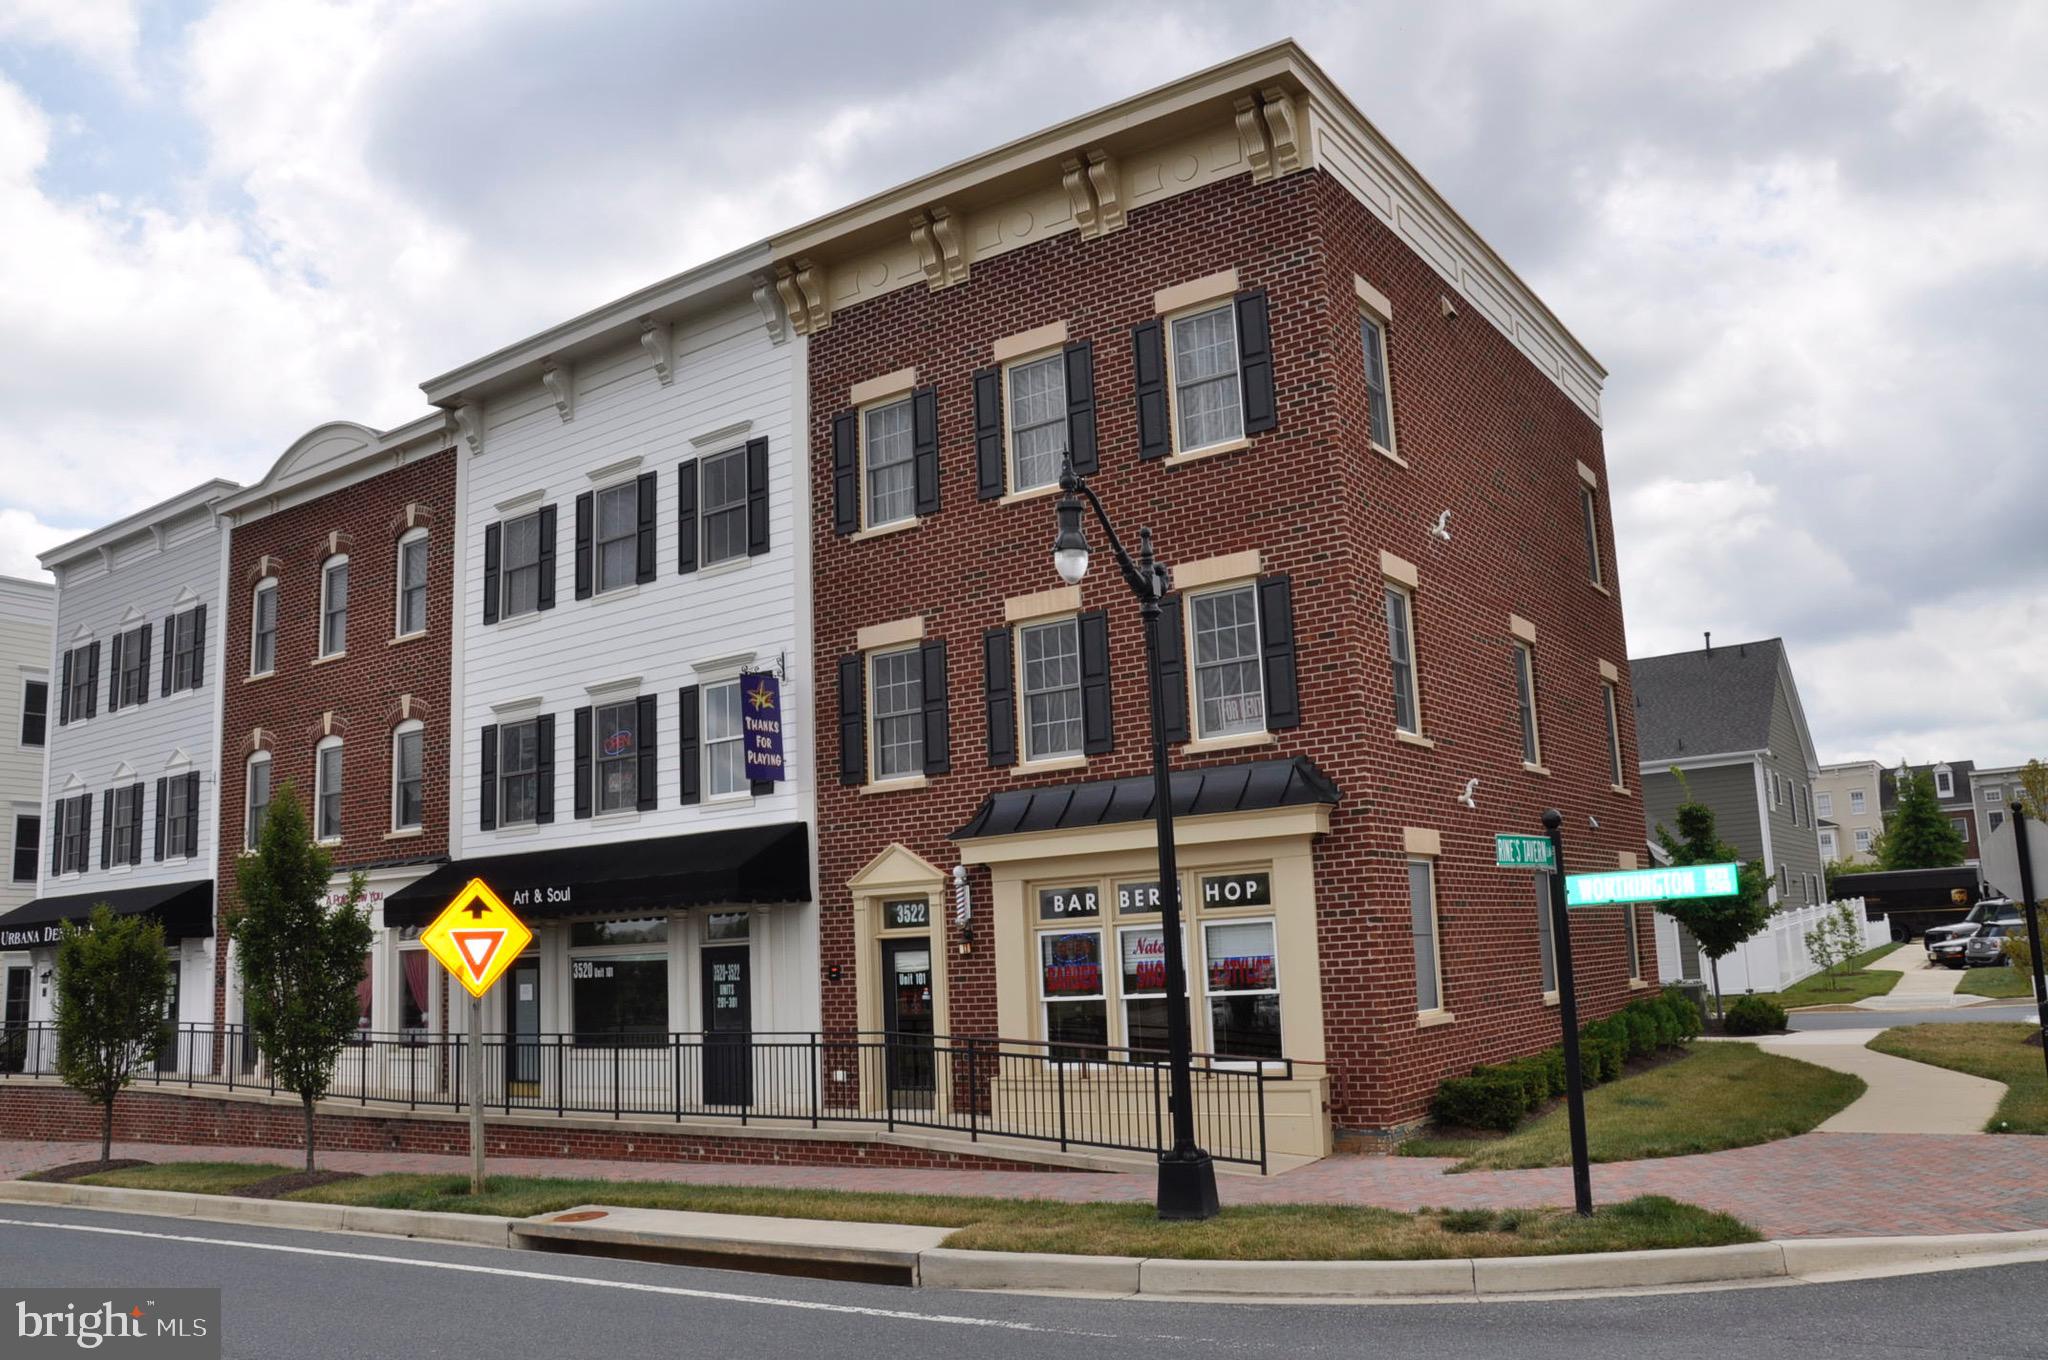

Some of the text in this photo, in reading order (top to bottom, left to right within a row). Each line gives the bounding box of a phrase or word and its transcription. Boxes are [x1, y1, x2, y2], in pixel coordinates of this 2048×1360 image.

[745, 716, 780, 733] THANKS
[756, 735, 772, 749] FOR
[747, 750, 782, 767] PLAYING
[1498, 838, 1521, 862] RINE'S
[1523, 840, 1547, 863] TAVERN
[1578, 871, 1696, 900] WORTHINGTON
[513, 886, 571, 905] Art & Soul
[897, 903, 925, 923] 3522
[1, 930, 40, 945] URBANA
[44, 926, 82, 942] DENAL
[573, 961, 593, 979] 3520
[594, 967, 605, 978] Unit
[899, 972, 927, 986] Unit 101
[1136, 960, 1166, 990] SHO
